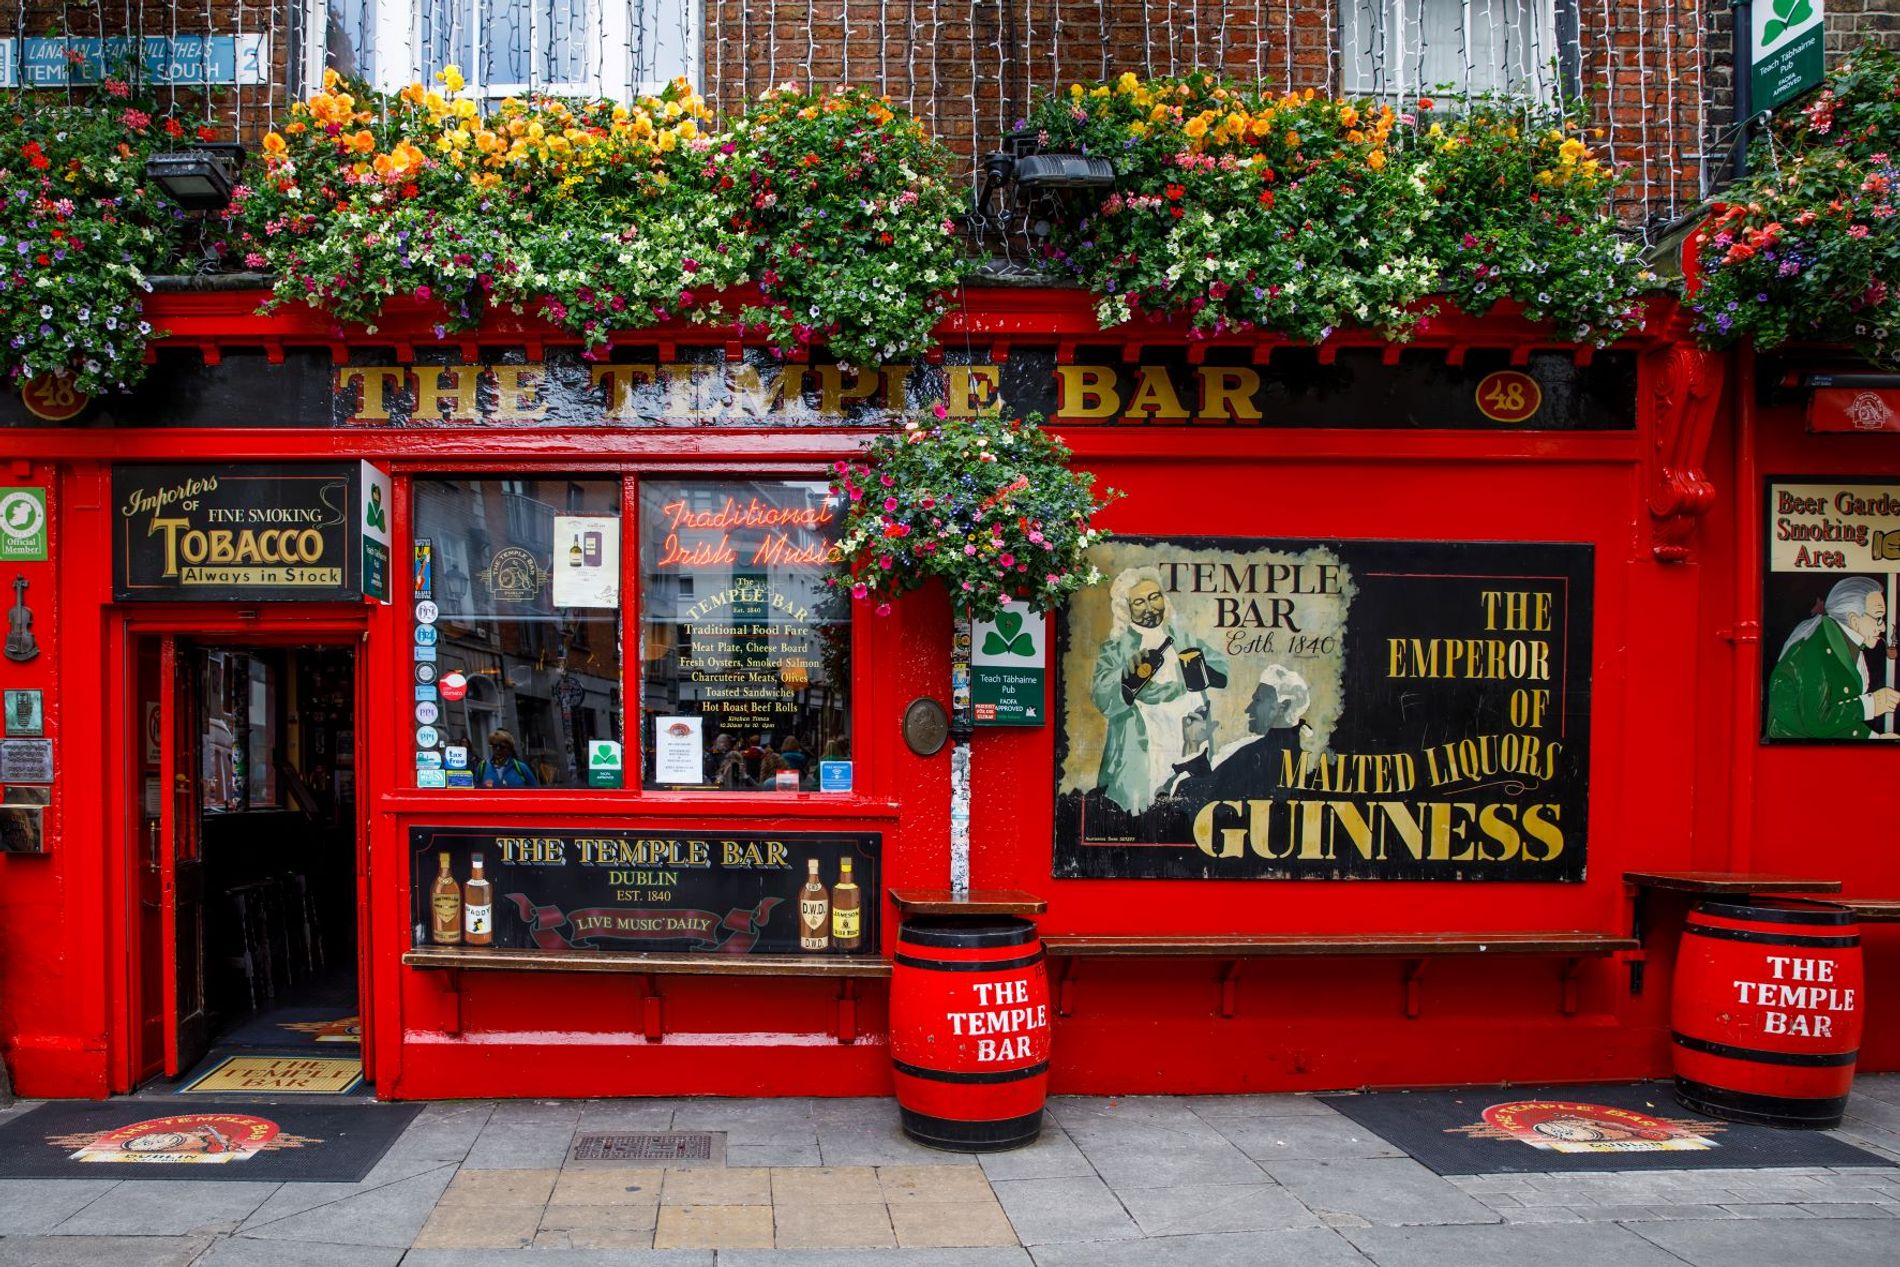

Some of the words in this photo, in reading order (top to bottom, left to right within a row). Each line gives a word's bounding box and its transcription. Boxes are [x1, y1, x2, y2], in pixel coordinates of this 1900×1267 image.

[157, 62, 219, 79] SOUTH
[243, 47, 260, 71] 2
[1759, 58, 1780, 76] Teach
[1780, 62, 1794, 74] Pub
[1772, 76, 1802, 97] APPROVED
[33, 374, 75, 407] 48
[338, 365, 549, 420] THE
[592, 364, 1001, 420] TEMPLE
[1056, 364, 1262, 420] BAR
[1484, 377, 1527, 411] 48
[121, 474, 219, 517] Importers
[182, 500, 201, 512] OF
[1777, 490, 1828, 516] Beer
[208, 508, 244, 523] FINE
[248, 508, 323, 523] SMOKING
[664, 495, 833, 530] Traditional
[7, 537, 36, 546] Official
[1777, 517, 1870, 547] Smoking
[5, 545, 39, 554] Member
[147, 517, 325, 578] TOBACCO
[499, 550, 528, 560] TEMPLE
[658, 534, 735, 567] Irish
[753, 533, 845, 565] Music
[1794, 544, 1847, 568] Area
[184, 567, 250, 583] Always
[261, 569, 277, 582] in
[285, 567, 338, 582] Stock
[736, 577, 754, 587] The
[1159, 562, 1343, 595] TEMPLE
[686, 588, 766, 621] TEMPLE
[772, 593, 809, 623] BAR
[1214, 598, 1302, 633] BAR
[1481, 591, 1552, 631] THE
[684, 624, 748, 635] Traditional
[752, 624, 779, 635] Food
[784, 624, 808, 635] Fare
[692, 642, 714, 652] Meat
[717, 642, 743, 654] Plate,
[746, 642, 778, 652] Cheese
[781, 643, 808, 653] Board
[1289, 635, 1335, 655] 1840
[680, 657, 704, 667] Fresh
[708, 657, 744, 670] Oysters,
[747, 657, 782, 667] Smoked
[785, 657, 820, 668] Salmon
[1386, 638, 1550, 680] EMPEROR
[691, 672, 745, 683] Charcuterie
[748, 672, 777, 684] Meats,
[780, 673, 809, 683] Olives
[980, 673, 1001, 683] Teach
[1002, 674, 1038, 684] Tábhairne
[1001, 685, 1016, 694] Pub
[705, 686, 740, 697] Toasted
[743, 686, 795, 697] Sandwiches
[702, 702, 719, 712] Hot
[723, 702, 748, 712] Roast
[751, 702, 771, 712] Beef
[775, 702, 798, 712] Rolls
[1510, 688, 1550, 728] OF
[1277, 748, 1416, 793] MALTED
[1423, 734, 1563, 787] LIQUORS
[1192, 800, 1565, 861] GUINNESS
[496, 837, 567, 866] THE
[574, 838, 711, 869] TEMPLE
[720, 840, 792, 870] BAR
[608, 871, 679, 886] DUBLIN
[616, 889, 643, 902] EST.
[647, 890, 671, 902] 1840
[577, 916, 612, 931] LIVE
[618, 917, 663, 931] MUSIC
[667, 917, 713, 931] DAILY
[1765, 955, 1834, 982] THE
[973, 980, 1028, 1006] THE
[1733, 980, 1855, 1011] TEMPLE
[947, 1004, 1046, 1036] TEMPLE
[1764, 1011, 1833, 1038] BAR
[977, 1036, 1032, 1062] BAR
[224, 1069, 357, 1078] TEMPLE
[270, 1060, 332, 1069] THE
[241, 1078, 310, 1087] BAR
[1502, 1102, 1594, 1116] TEMPLE
[1604, 1109, 1658, 1128] BAR
[111, 1124, 158, 1140] THE
[158, 1114, 257, 1127] TEMPLE
[246, 1124, 270, 1141] BAR
[1589, 1141, 1665, 1149] DUBLIN
